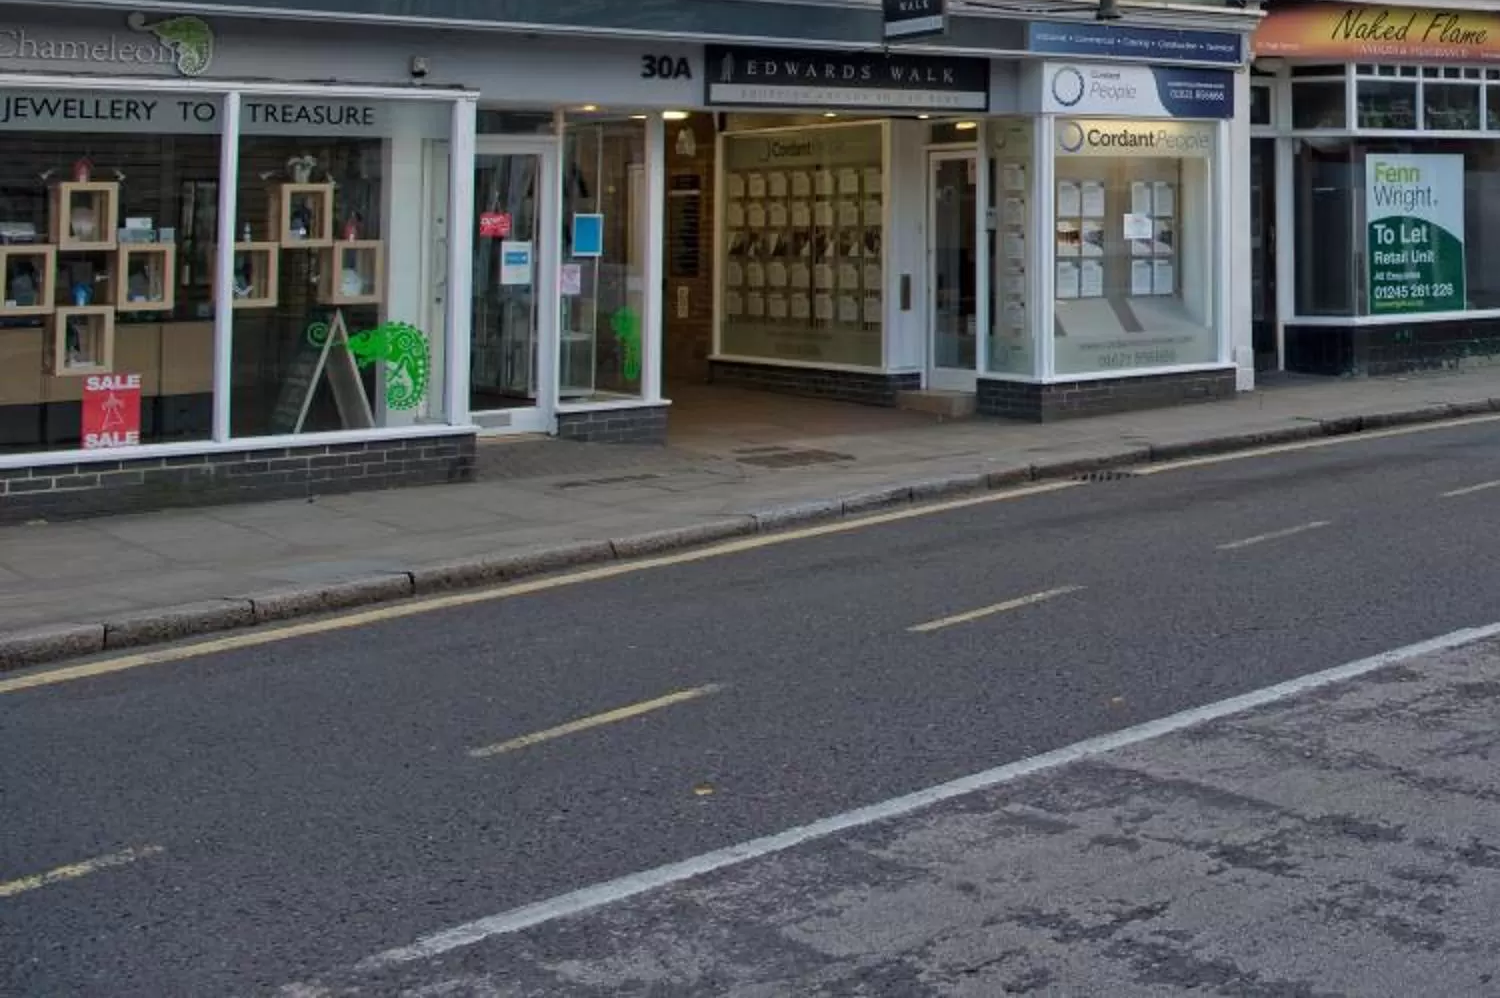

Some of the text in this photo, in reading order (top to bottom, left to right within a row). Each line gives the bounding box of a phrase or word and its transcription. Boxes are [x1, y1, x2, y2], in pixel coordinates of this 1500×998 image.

[1331, 9, 1489, 45] Naked Flame
[0, 27, 177, 63] Chameleon
[640, 54, 692, 80] 30A
[747, 60, 954, 84] EDWARDS WALK
[1090, 81, 1137, 102] People
[1, 96, 375, 126] JEWELLERY TO TREASURE
[1374, 162, 1420, 183] Fenn
[1373, 223, 1428, 245] To Let
[1374, 249, 1435, 265] Retail Unit
[1374, 284, 1409, 299] 01245
[85, 373, 141, 391] SALE
[84, 431, 140, 449] SALE
